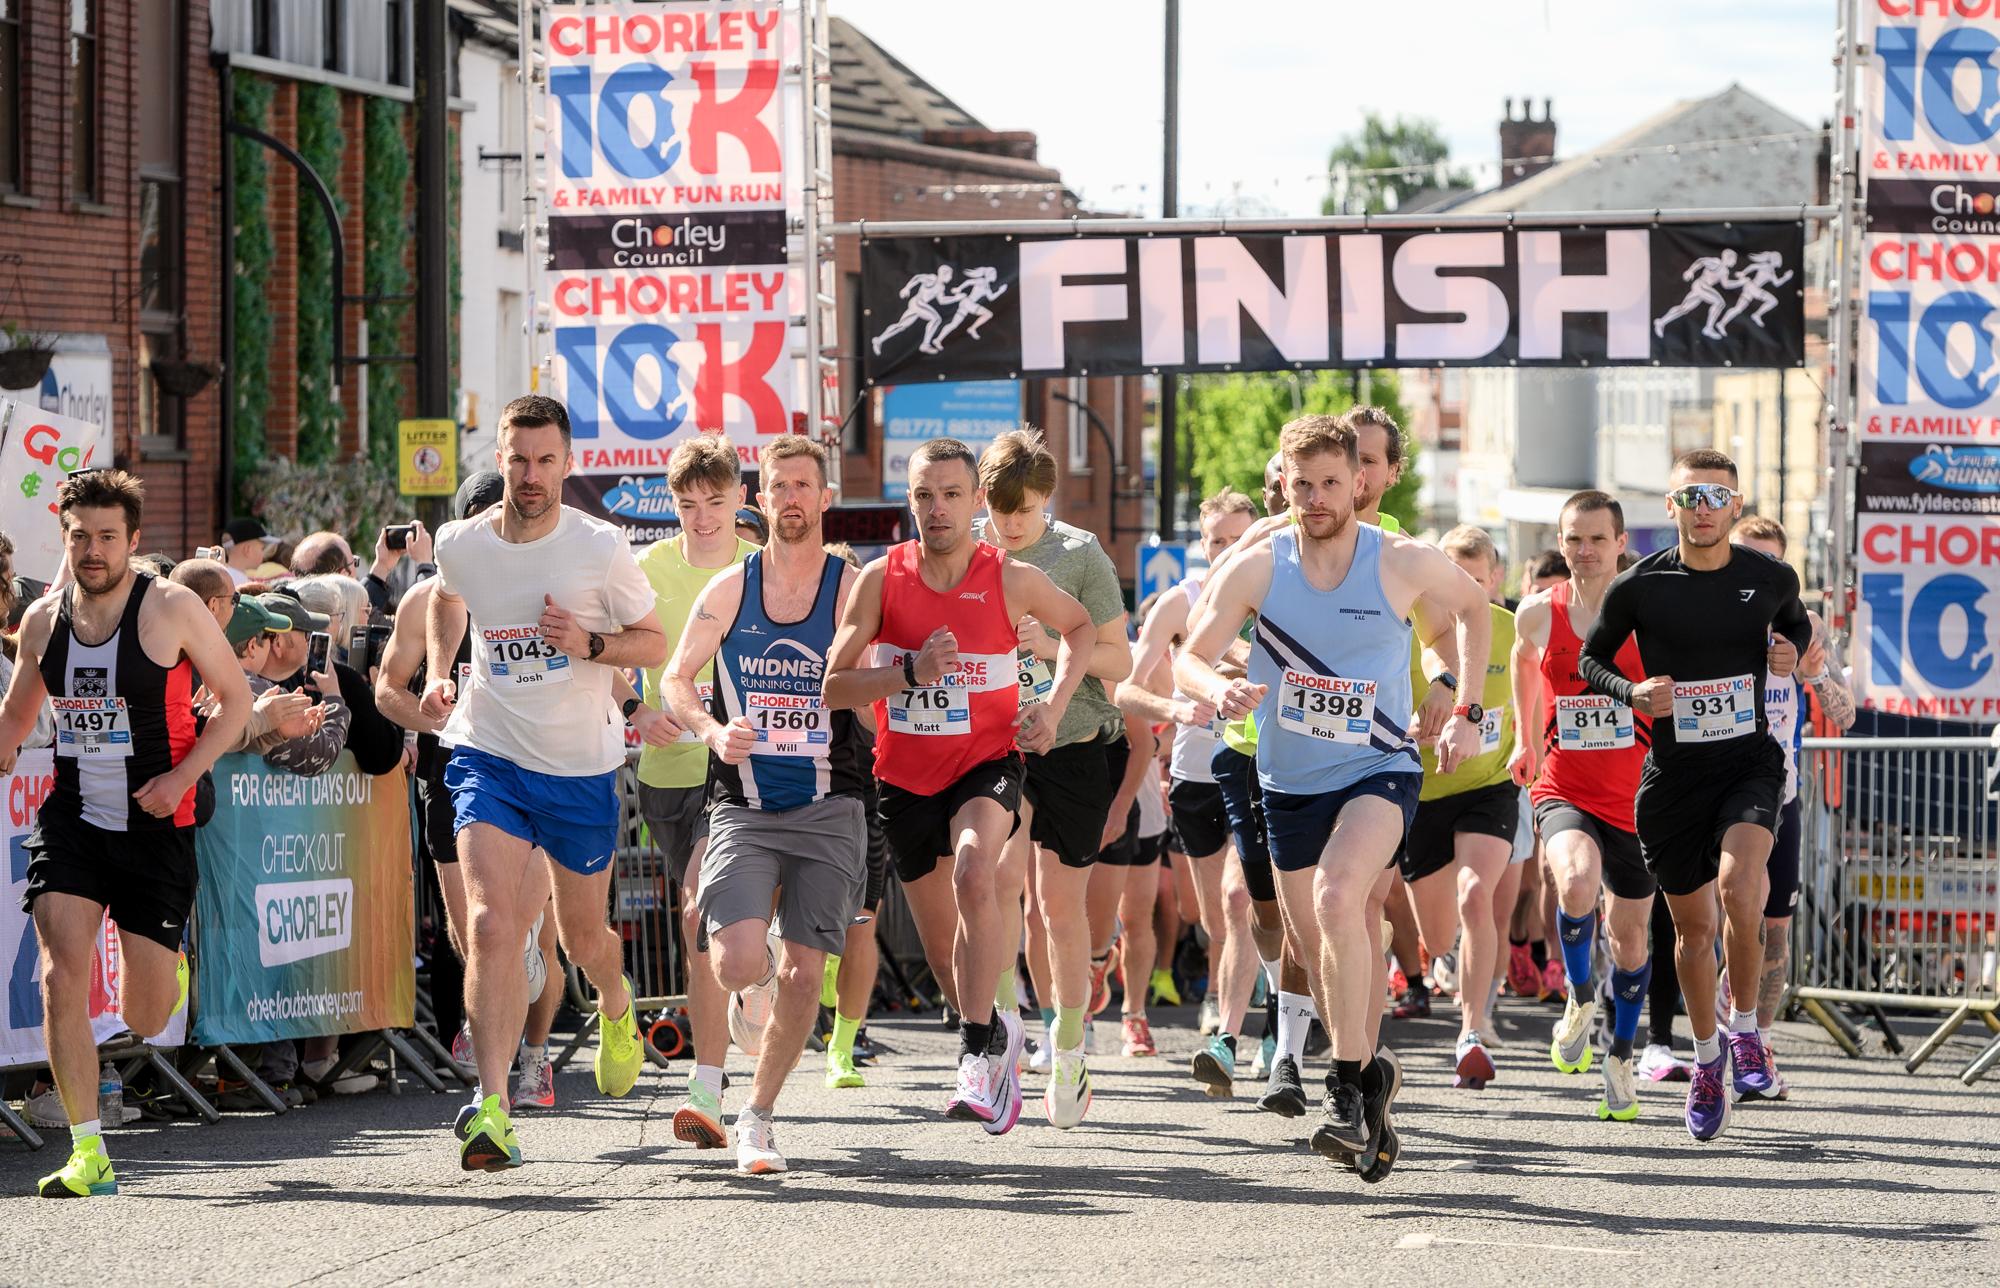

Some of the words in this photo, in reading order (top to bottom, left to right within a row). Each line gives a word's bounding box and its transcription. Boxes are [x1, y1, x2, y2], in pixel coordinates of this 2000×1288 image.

[549, 10, 779, 56] CHORLEY
[549, 60, 782, 179] 10K
[1873, 154, 1888, 169] &
[1897, 152, 1989, 171] FAMILY
[553, 189, 569, 207] &
[576, 187, 666, 206] FAMILY
[674, 185, 724, 203] FUN
[732, 184, 782, 202] RUN
[611, 218, 726, 252] Chorley
[613, 249, 703, 267] Council
[555, 272, 784, 316] CHORLEY
[1018, 229, 1651, 371] FINISH
[555, 322, 787, 440] 10K
[1867, 416, 1882, 434] &
[1890, 415, 1982, 436] FAMILY
[406, 432, 448, 440] LITTER
[583, 448, 672, 468] FAMILY
[484, 627, 539, 640] CHORLEY
[738, 655, 824, 679] WIDNES
[516, 674, 543, 683] Josh
[741, 676, 791, 690] RUNNING
[794, 681, 821, 692] CLUB
[944, 674, 966, 686] 10K
[1018, 672, 1034, 687] 9
[1286, 671, 1352, 693] CHORLEY
[1352, 681, 1377, 696] 10K
[1674, 682, 1731, 697] CHORLEY
[1732, 678, 1752, 691] 10K
[52, 697, 103, 710] CHORLEY
[104, 698, 125, 709] 10K
[750, 694, 808, 708] CHORLEY
[901, 690, 950, 709] 716
[1293, 689, 1365, 718] 1398
[1560, 698, 1612, 708] CHORLEY
[1692, 695, 1735, 716] 931
[1884, 697, 1979, 719] FAMILY
[63, 712, 118, 731] 1497
[757, 710, 819, 729] 1560
[914, 723, 940, 732] Matt
[1575, 710, 1618, 728] 814
[1311, 726, 1336, 739] Rob
[1702, 728, 1734, 737] Aaron
[84, 745, 101, 753] Ian
[776, 743, 797, 752] Will
[1581, 740, 1615, 748] James
[231, 774, 260, 806] FOR
[263, 774, 308, 806] GREAT
[312, 774, 343, 804] DAYS
[346, 774, 373, 804] OUT
[262, 834, 317, 874] CHECK
[318, 833, 345, 872] OUT
[266, 891, 347, 945] CHORLEY
[248, 986, 364, 1021] checkoutchorley.com
